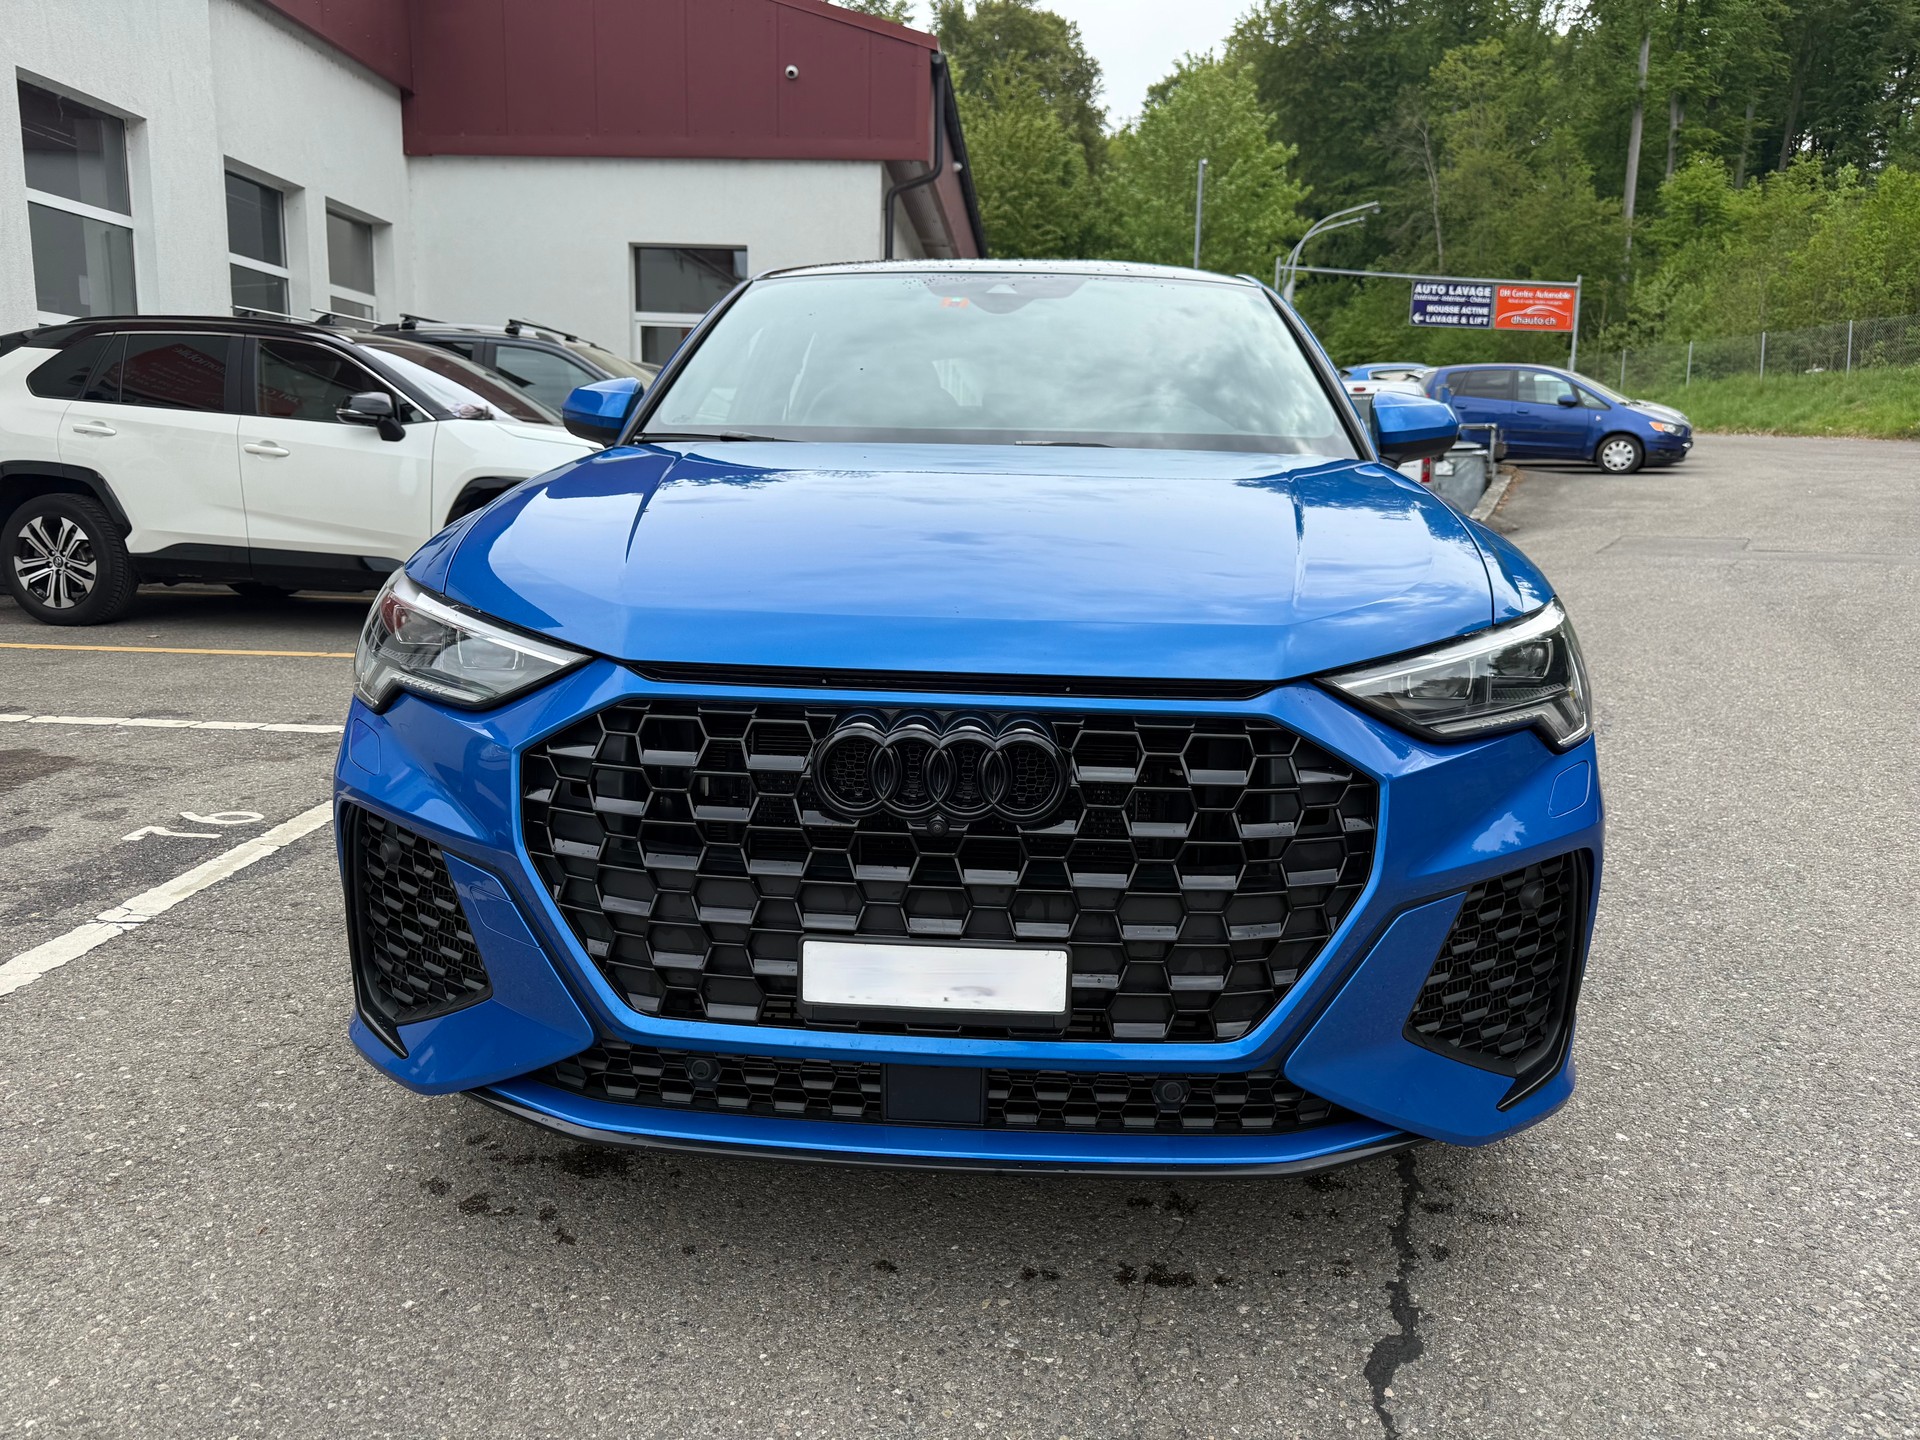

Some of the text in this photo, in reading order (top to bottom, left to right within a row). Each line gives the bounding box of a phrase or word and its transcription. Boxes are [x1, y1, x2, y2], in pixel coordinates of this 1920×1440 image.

[1414, 283, 1492, 297] AUTO LAVAGE
[1535, 290, 1571, 299] Automobile
[1426, 304, 1490, 316] MOUSSE ACTIVE
[1425, 314, 1460, 324] LAVAGE
[1469, 316, 1489, 325] LIFT
[1510, 315, 1557, 326] dhauto.ch
